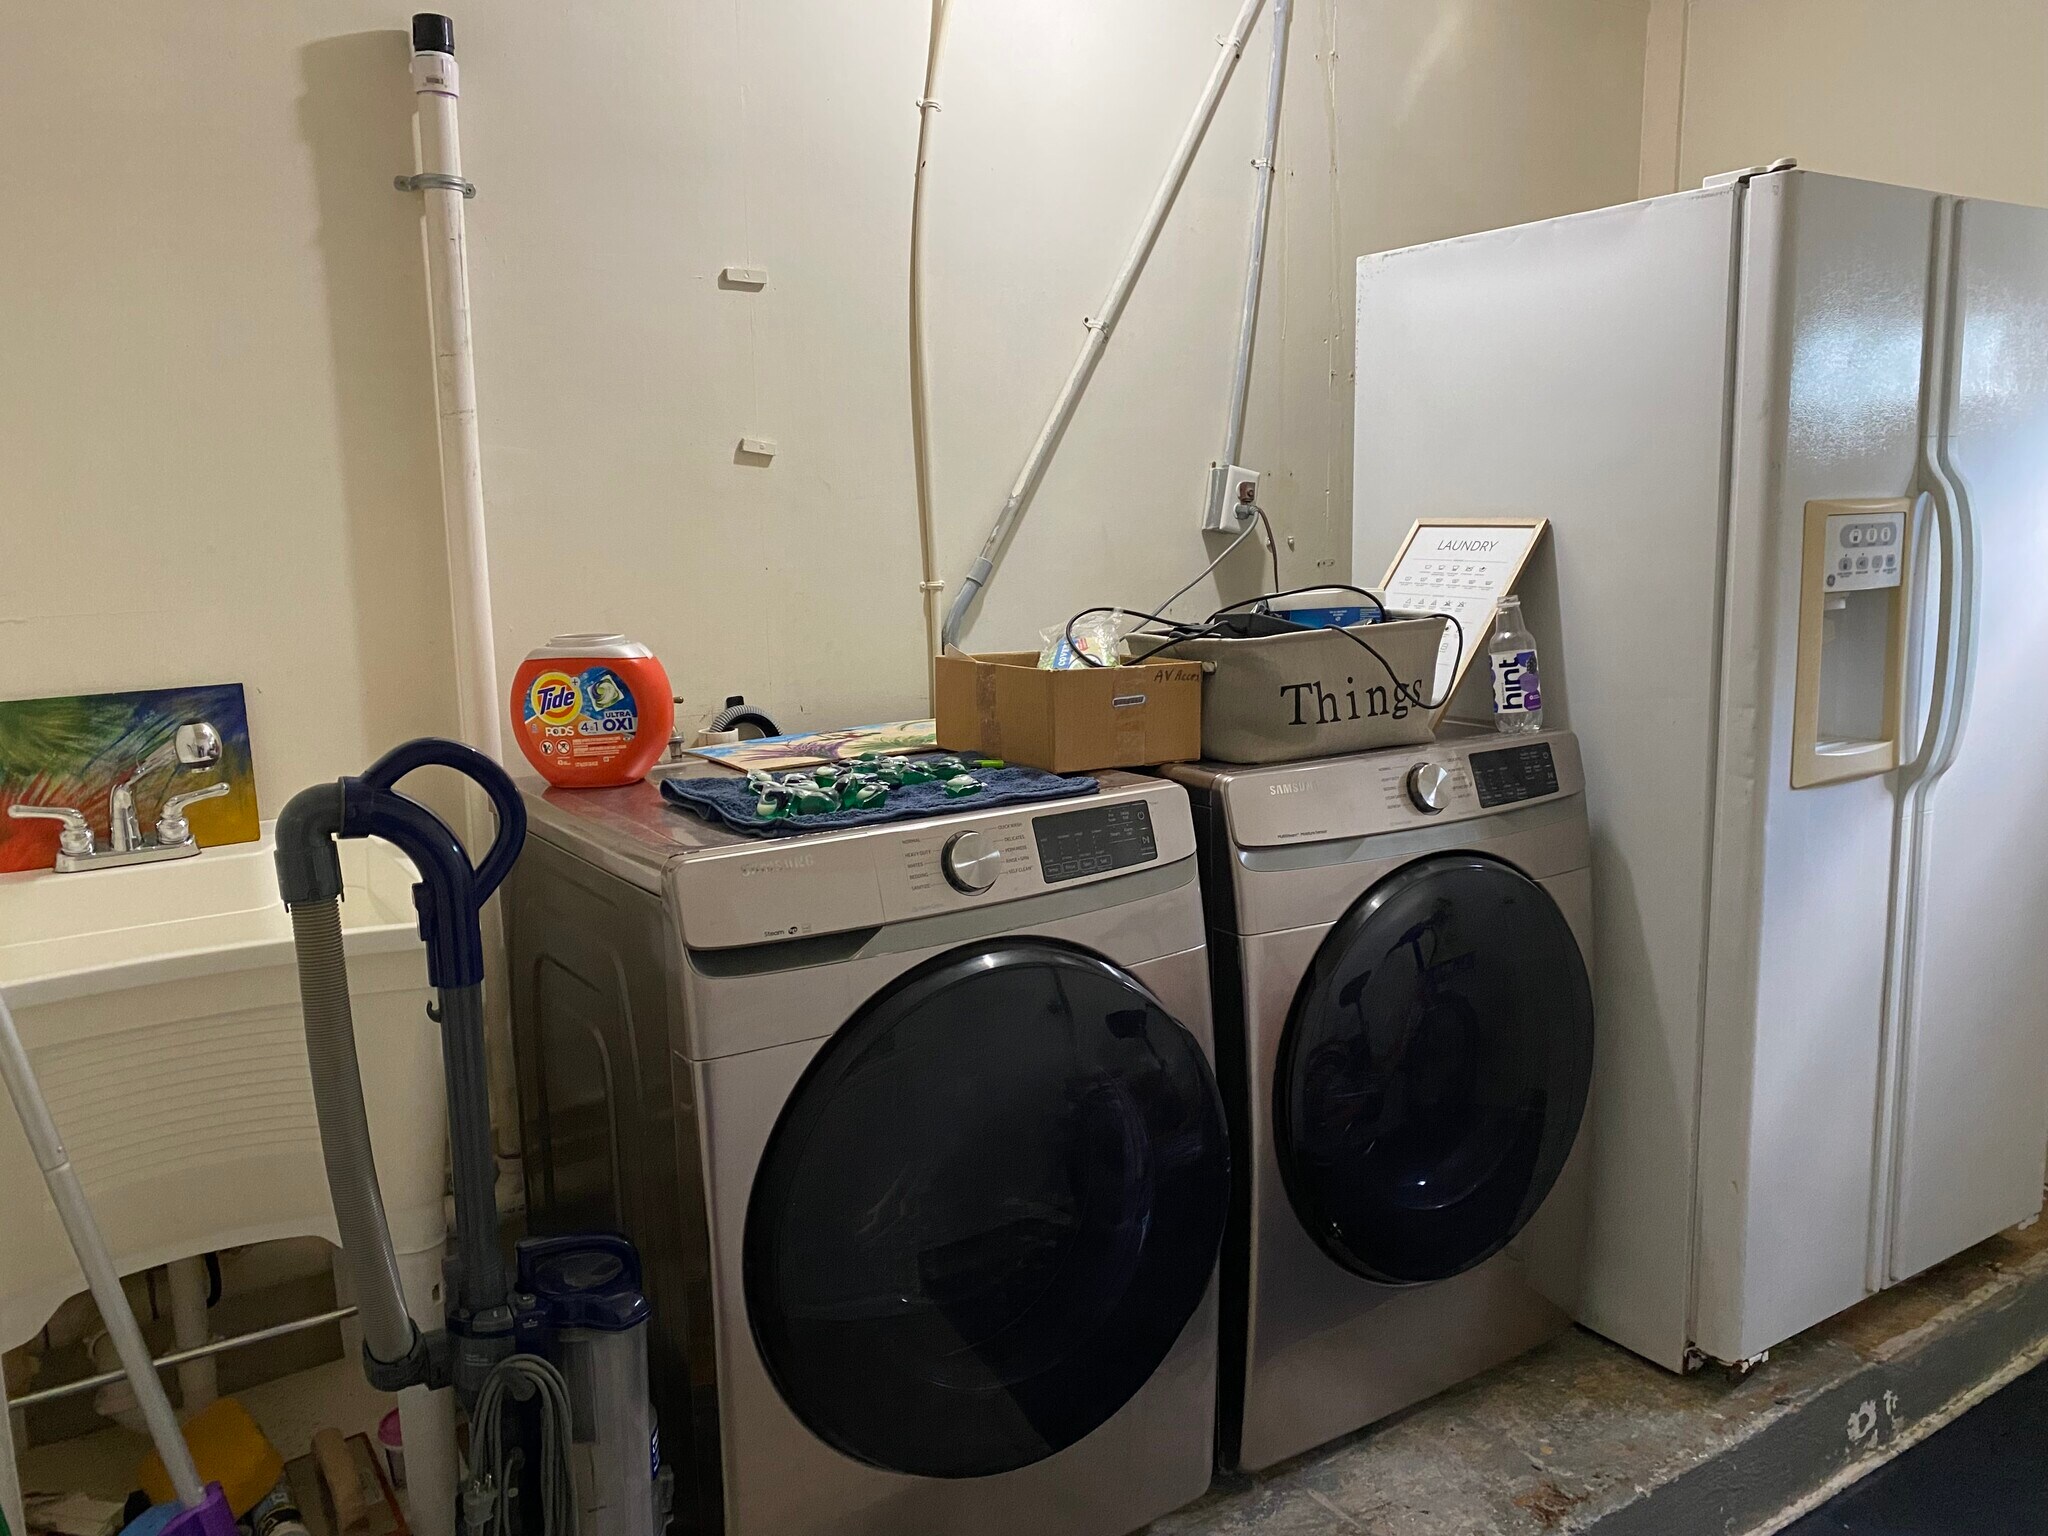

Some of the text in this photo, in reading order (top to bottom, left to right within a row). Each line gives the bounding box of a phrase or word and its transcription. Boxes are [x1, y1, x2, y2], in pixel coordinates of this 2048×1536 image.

[1437, 540, 1499, 552] LAUNDRY
[1154, 667, 1174, 683] AV
[1499, 657, 1523, 709] hint
[537, 686, 576, 715] Tide
[1280, 676, 1423, 726] Things
[605, 710, 632, 718] ULTRA
[545, 726, 575, 737] PODS
[602, 717, 634, 732] OXI
[764, 929, 785, 937] Steam
